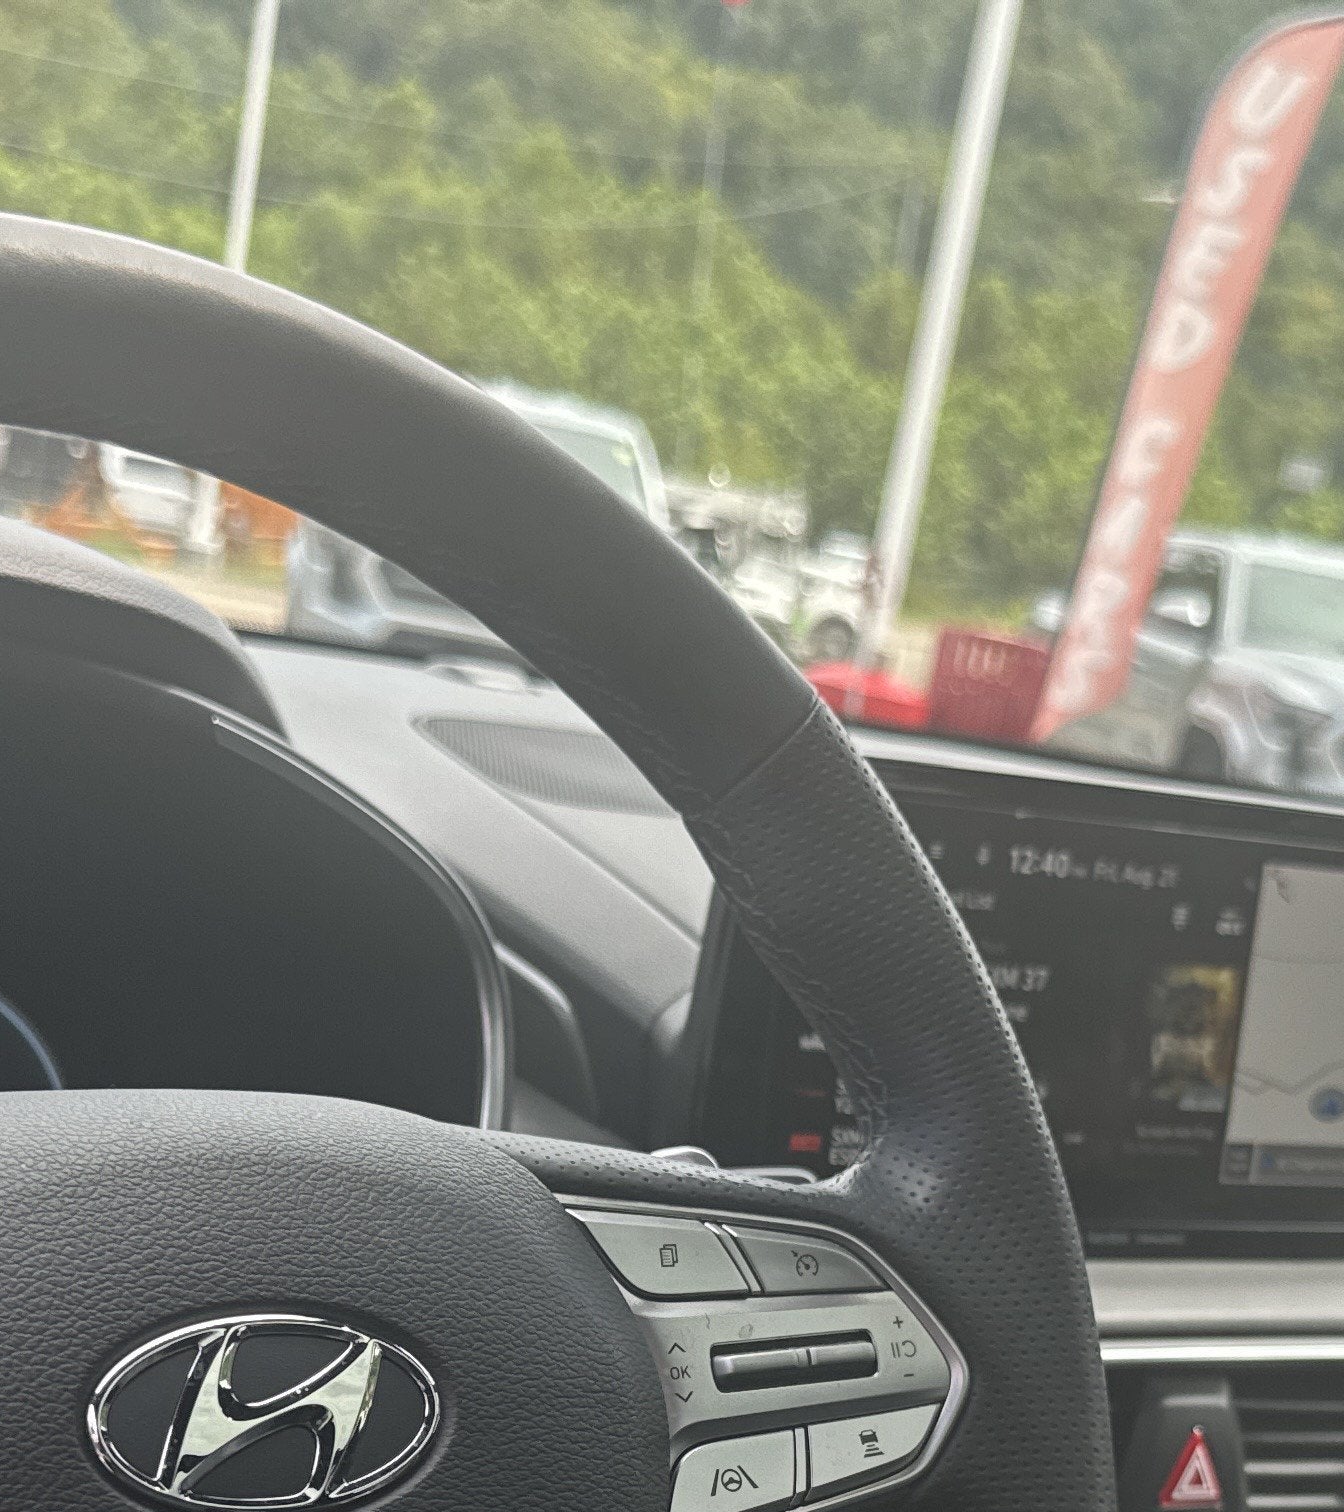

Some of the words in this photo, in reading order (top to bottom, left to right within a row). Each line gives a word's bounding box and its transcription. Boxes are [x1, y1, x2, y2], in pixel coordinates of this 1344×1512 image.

[1153, 60, 1311, 375] USED
[1009, 845, 1073, 879] 12:40
[669, 1365, 692, 1381] OK
